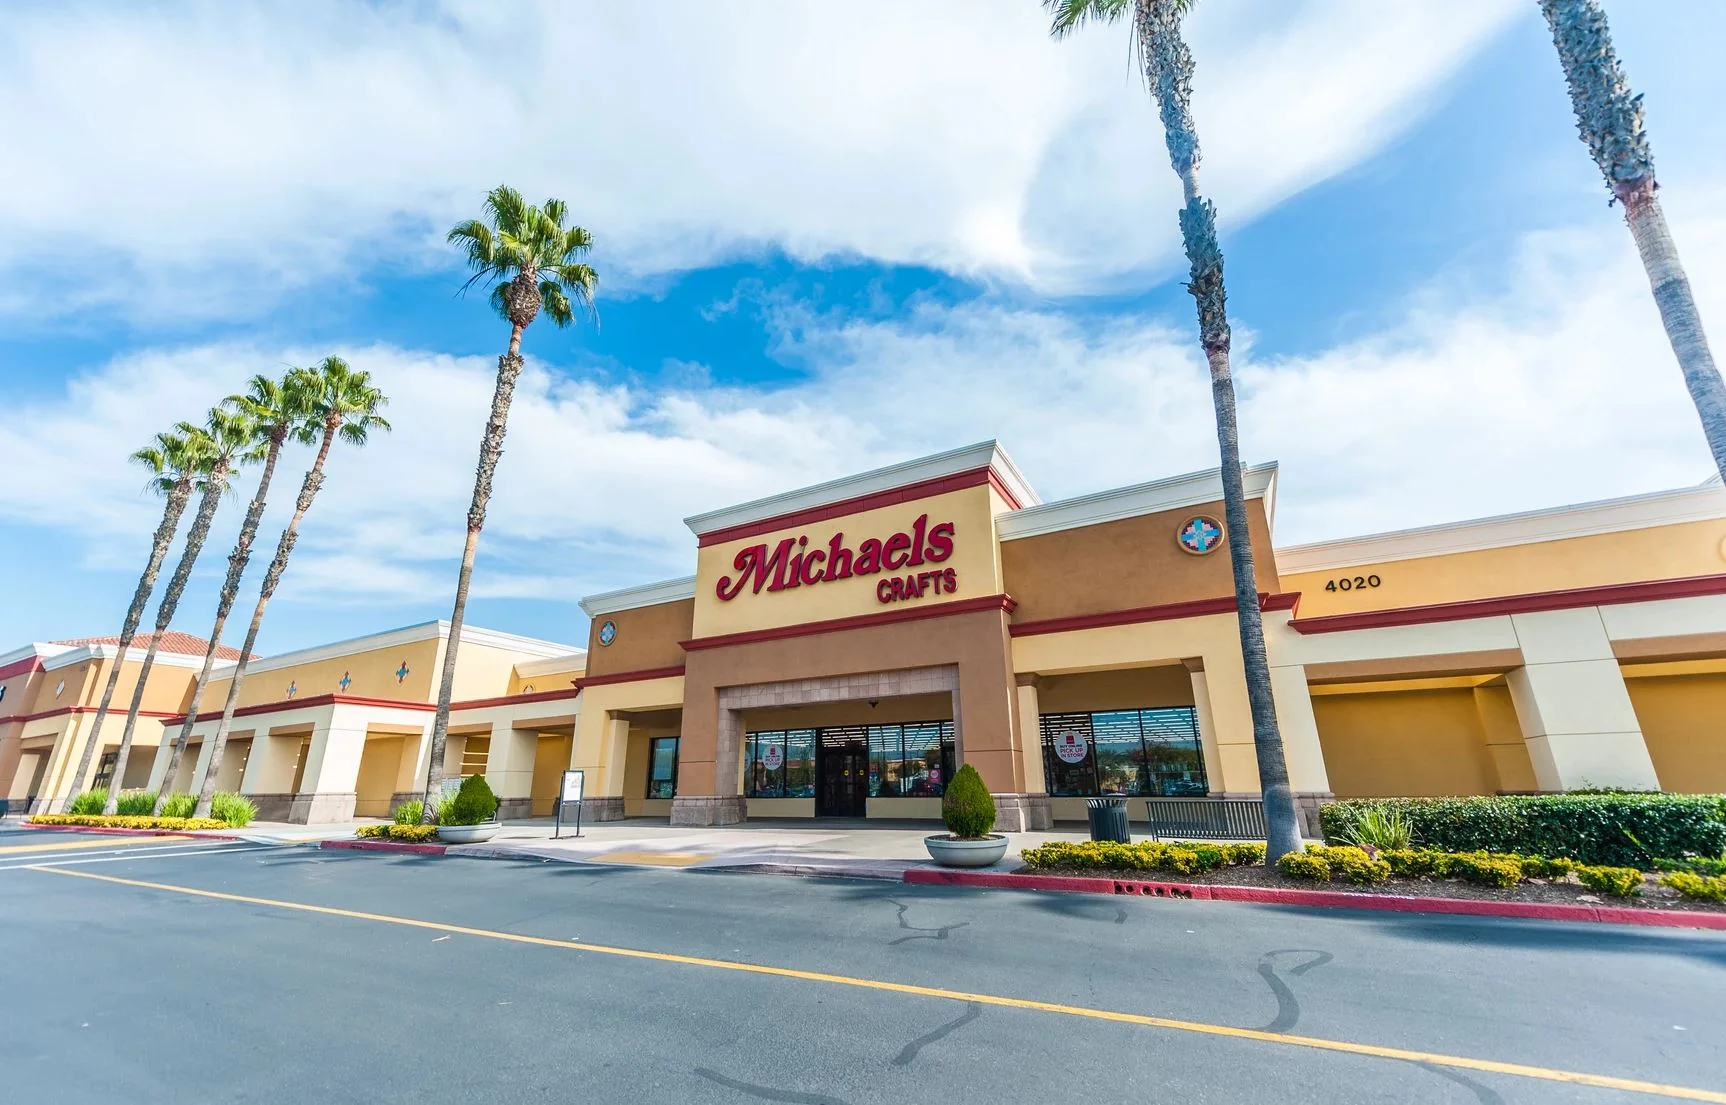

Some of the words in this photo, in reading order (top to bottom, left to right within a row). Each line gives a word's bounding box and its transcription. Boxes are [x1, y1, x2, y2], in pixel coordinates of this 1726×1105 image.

[715, 513, 955, 601] Michaels
[876, 567, 957, 604] CRAFTS
[1325, 575, 1381, 592] 4020
